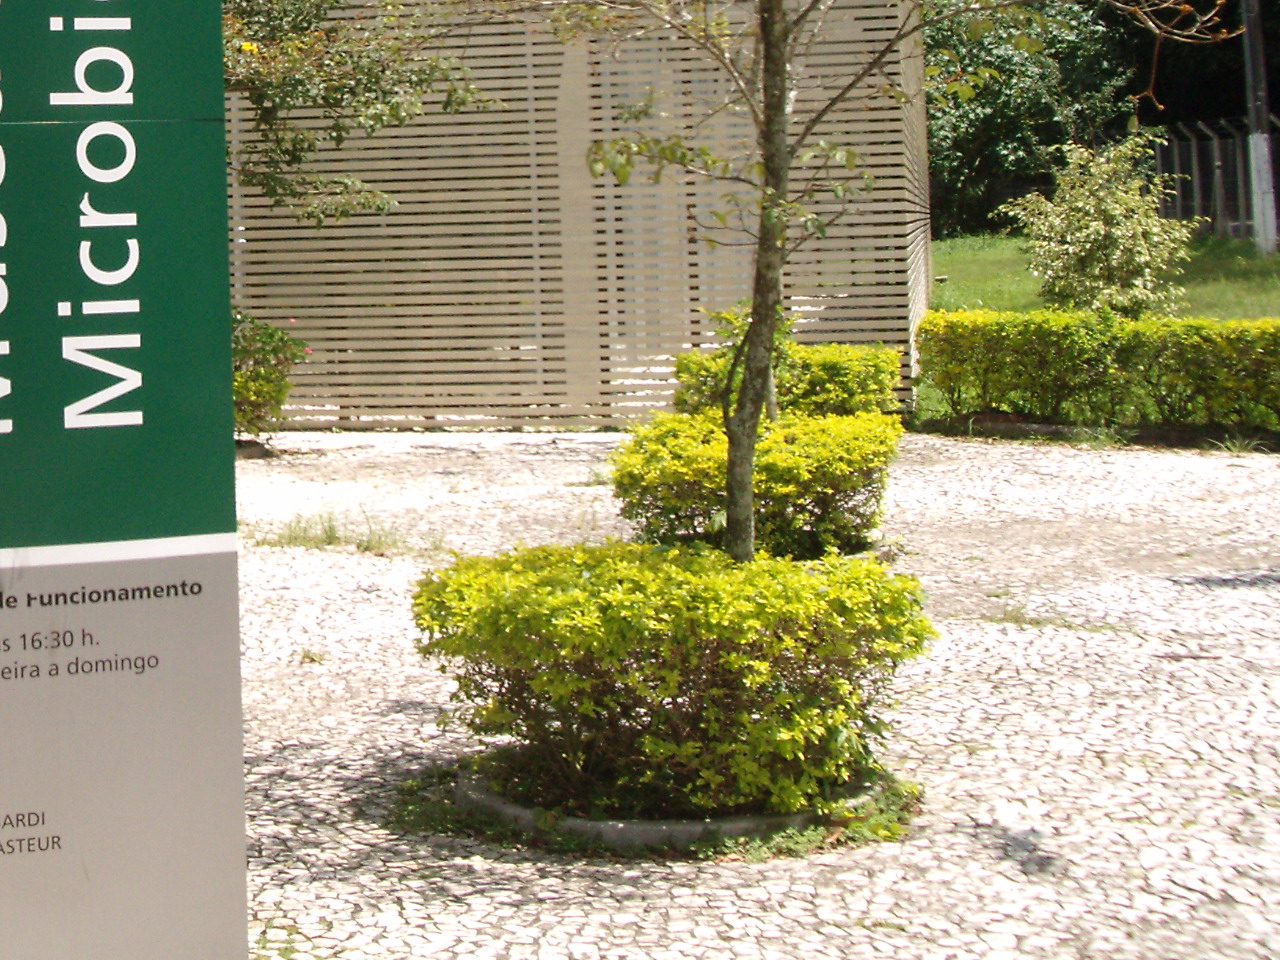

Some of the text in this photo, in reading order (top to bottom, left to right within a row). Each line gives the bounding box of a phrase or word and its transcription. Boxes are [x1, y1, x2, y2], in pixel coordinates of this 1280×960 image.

[26, 580, 202, 607] Funcionamento
[20, 630, 74, 651] 16:30
[82, 629, 100, 646] h.
[48, 663, 59, 677] a
[67, 654, 159, 675] domingo
